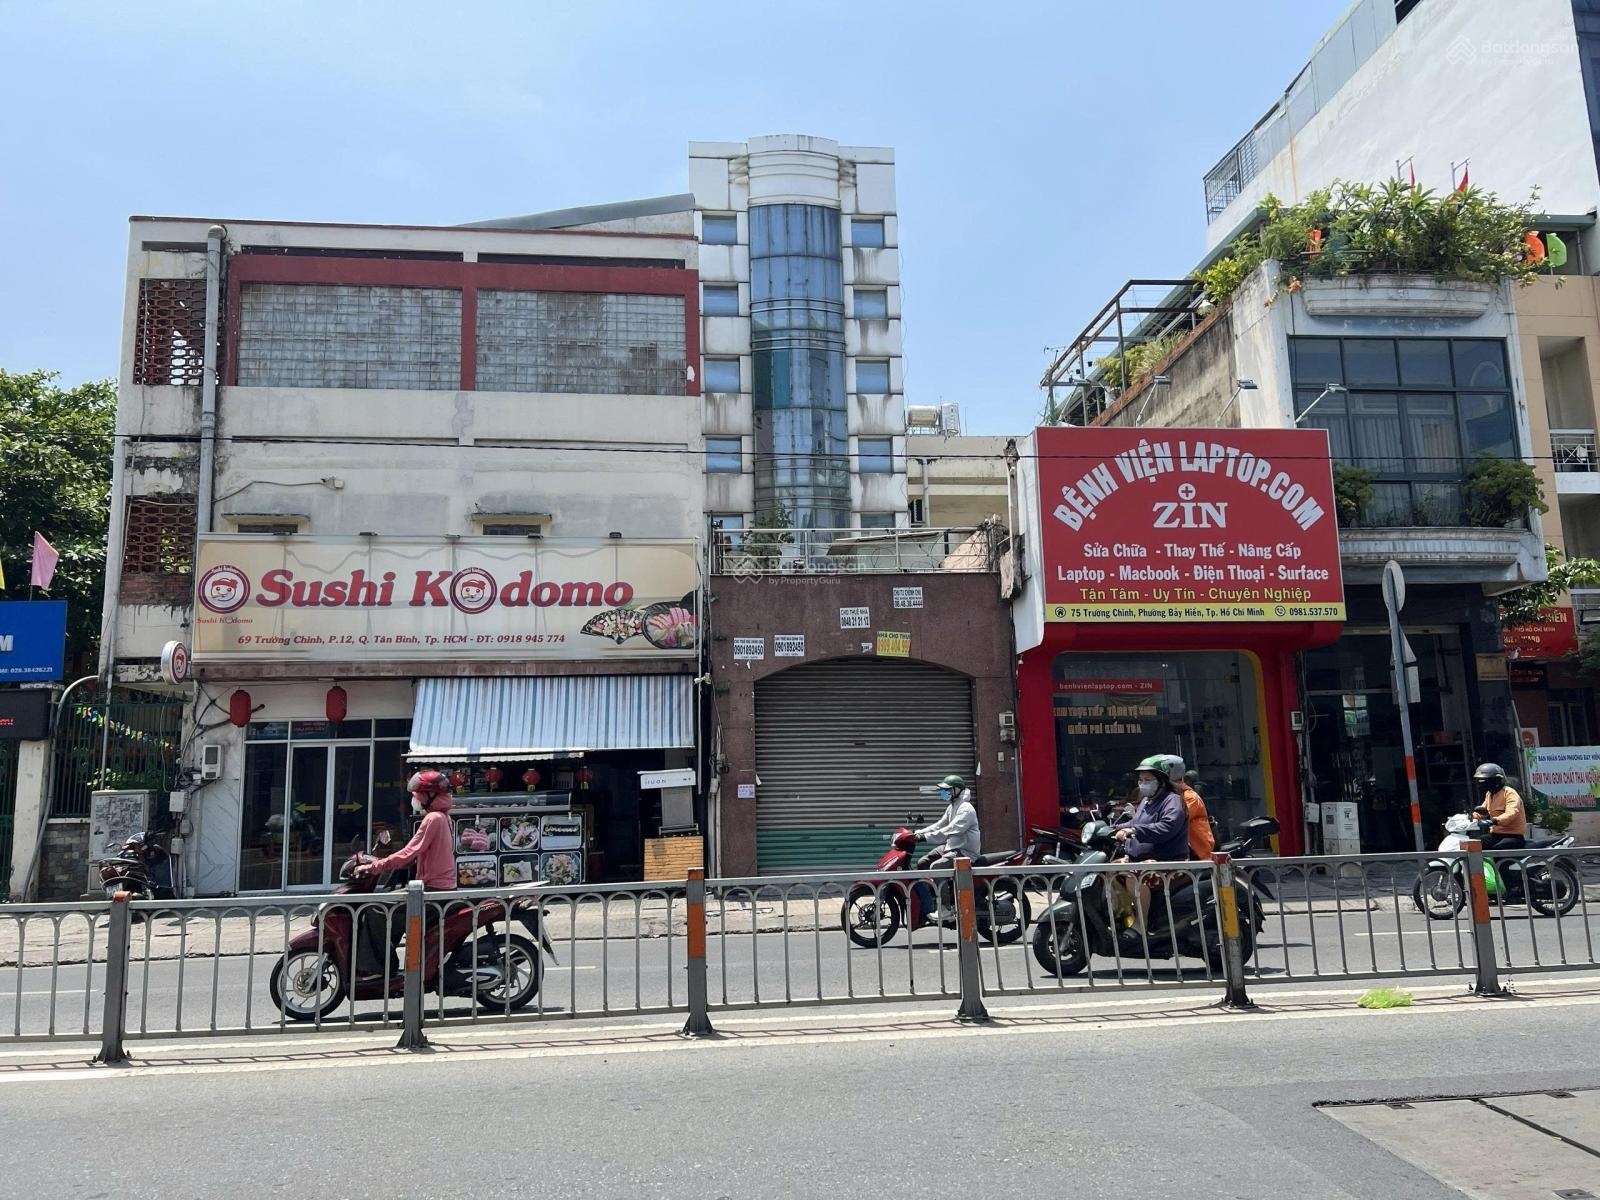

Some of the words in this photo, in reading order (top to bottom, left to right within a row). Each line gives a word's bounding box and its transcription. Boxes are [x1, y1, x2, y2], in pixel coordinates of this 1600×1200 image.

[1053, 463, 1119, 532] BỆNH
[1114, 438, 1175, 484] VIỆN
[1179, 441, 1325, 531] LAPTOP.COM
[1152, 502, 1228, 529] ZIN
[1083, 542, 1110, 558] Sửa
[1113, 543, 1147, 558] Chữa
[1164, 544, 1196, 560] Thay
[1200, 542, 1225, 558] Thế
[1238, 543, 1273, 560] Nâng
[1276, 541, 1302, 560] Cấp
[1057, 565, 1106, 582] Laptop
[1119, 565, 1180, 581] Macbook
[1193, 564, 1225, 582] Điện
[1227, 565, 1265, 582] Thoại
[1278, 565, 1329, 581] Surface
[255, 569, 396, 607] Sushi
[1080, 588, 1106, 602] Tận
[1110, 588, 1140, 600] Tâm
[1152, 588, 1170, 601] Uy
[1174, 587, 1196, 600] Tín
[1208, 587, 1263, 600] Chuyên
[1266, 588, 1312, 602] Nghiệp
[1071, 608, 1081, 618] 75
[1206, 607, 1218, 619] Tp.
[1246, 607, 1265, 617] Minh
[1289, 607, 1338, 617] 0981.537.570
[237, 636, 252, 644] 69
[293, 635, 325, 645] Chinh,
[328, 635, 354, 645] P.12,
[358, 635, 370, 645] Q.
[374, 634, 392, 644] Tân
[424, 635, 439, 646] Tp.
[443, 635, 468, 644] HCM
[476, 635, 495, 643] ĐT:
[497, 635, 522, 643] 0918
[525, 635, 544, 643] 945
[547, 635, 565, 643] 774
[1139, 682, 1153, 690] ZIN
